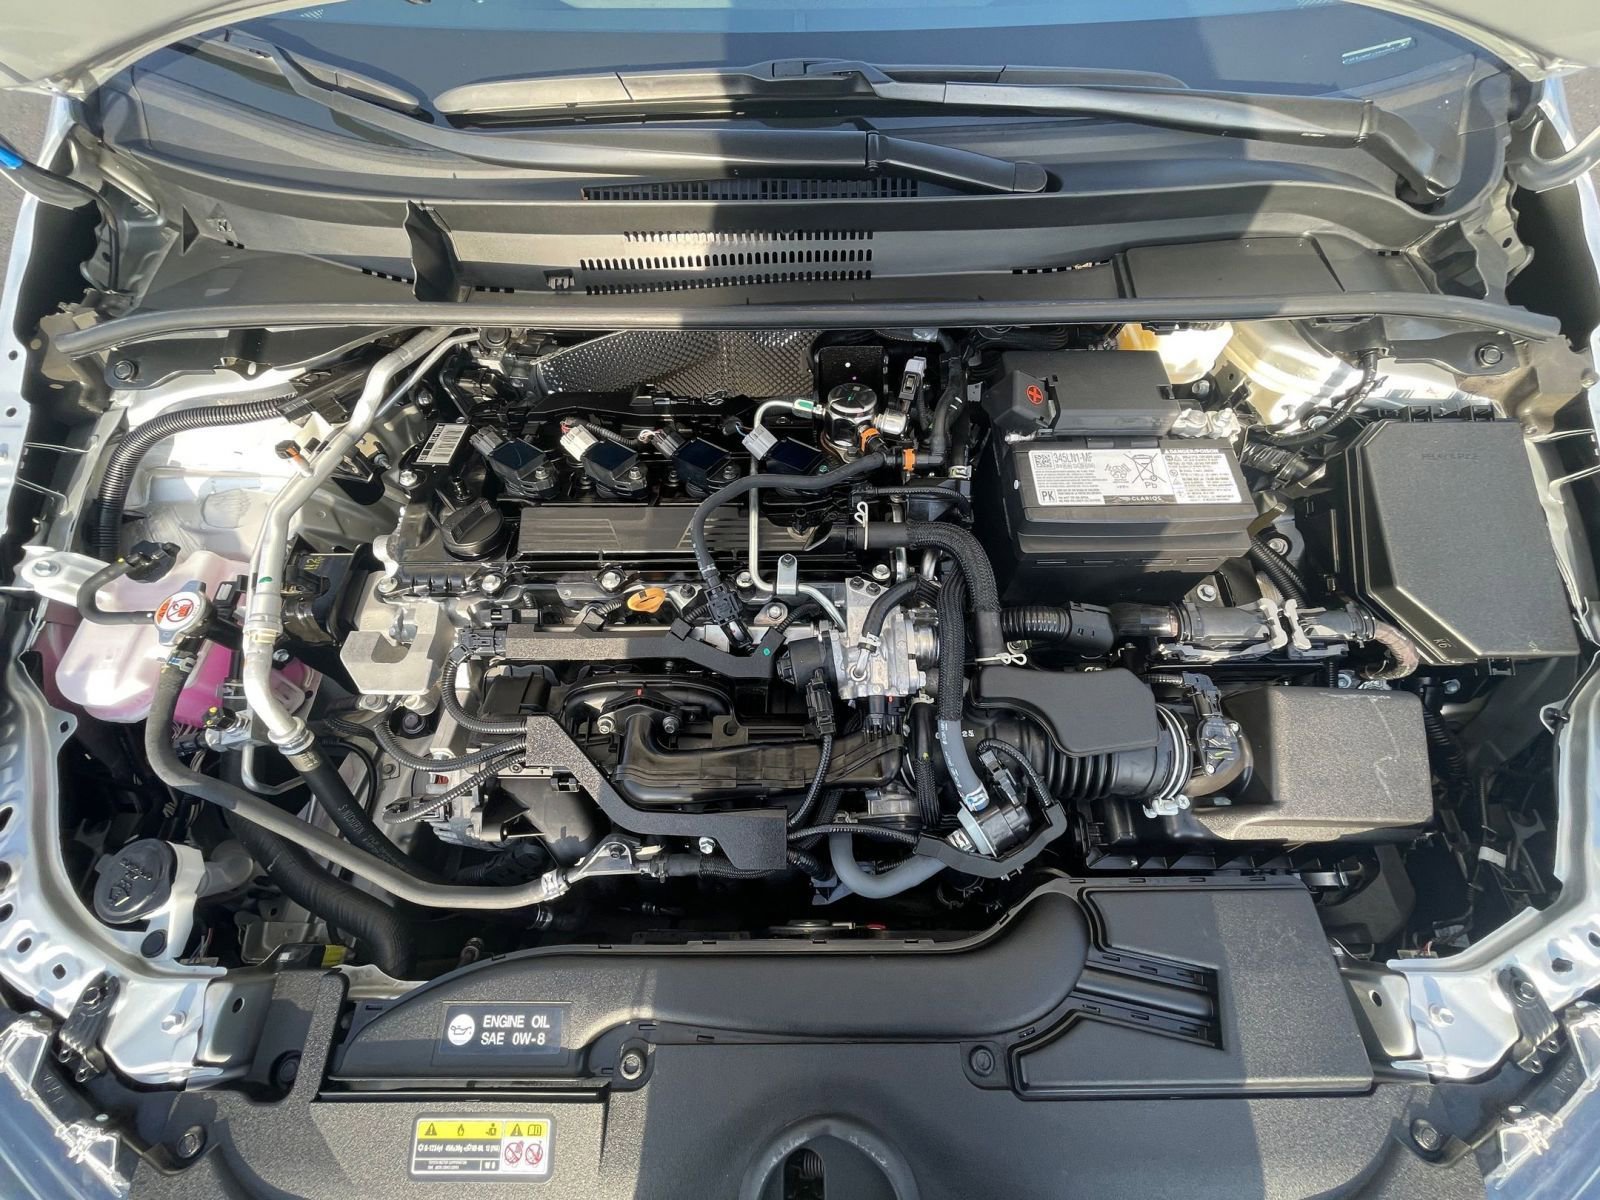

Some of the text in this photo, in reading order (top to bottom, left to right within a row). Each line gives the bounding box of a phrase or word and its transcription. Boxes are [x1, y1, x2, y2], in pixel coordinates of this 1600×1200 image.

[1144, 481, 1158, 489] Pb
[1041, 491, 1054, 502] PK
[483, 1014, 550, 1028] ENGINE OIL
[480, 1032, 546, 1046] SAE 0W-8
